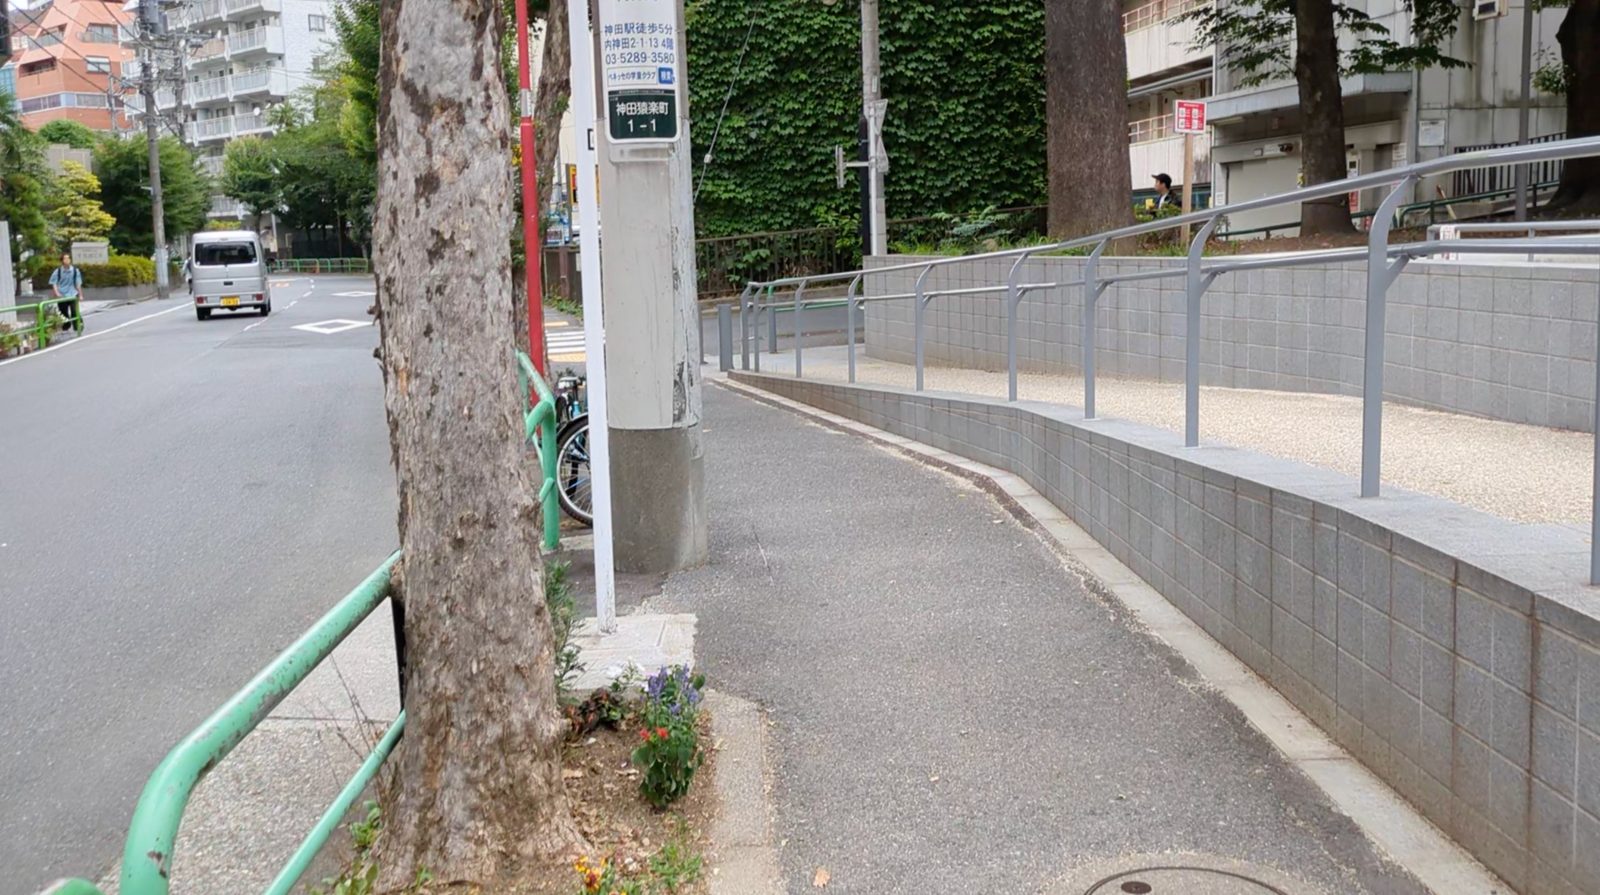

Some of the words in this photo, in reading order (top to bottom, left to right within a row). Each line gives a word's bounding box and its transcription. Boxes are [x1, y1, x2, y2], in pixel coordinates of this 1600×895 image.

[604, 22, 673, 36] 神田駅徒歩5分
[605, 51, 675, 65] 03-5289-3580
[616, 101, 669, 116] 神田猿楽町
